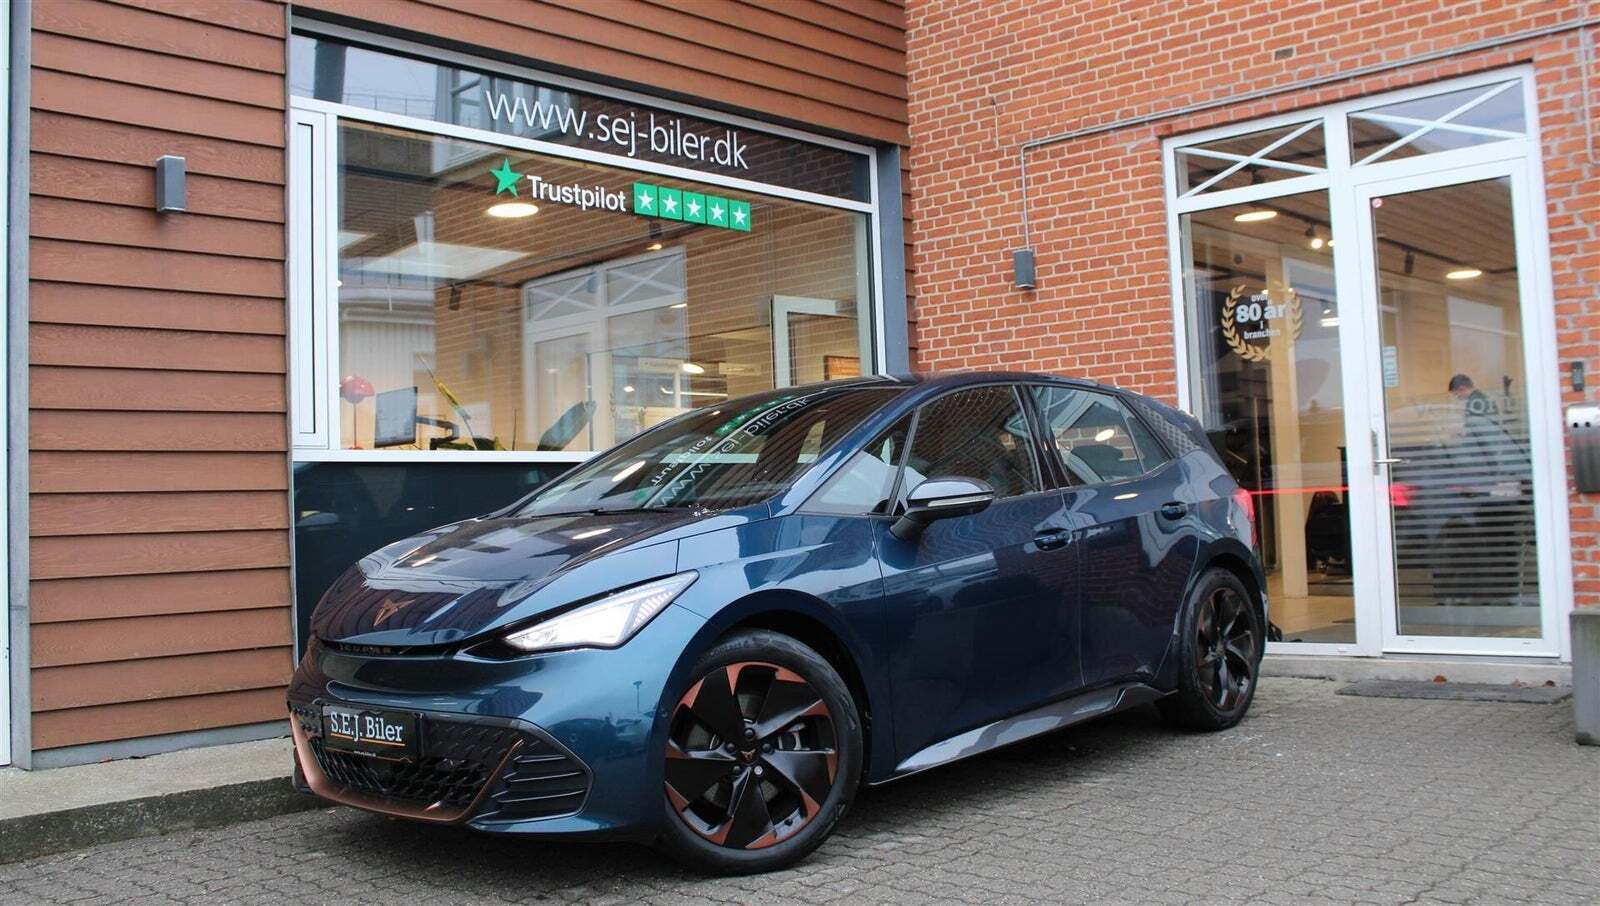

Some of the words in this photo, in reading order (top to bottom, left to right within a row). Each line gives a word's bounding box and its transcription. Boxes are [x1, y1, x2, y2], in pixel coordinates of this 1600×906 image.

[486, 90, 749, 170] www.sej-biler.dk
[526, 174, 627, 212] Trustpilot
[1235, 303, 1262, 323] 80
[330, 711, 363, 742] S.E.J.
[365, 715, 403, 742] Biler
